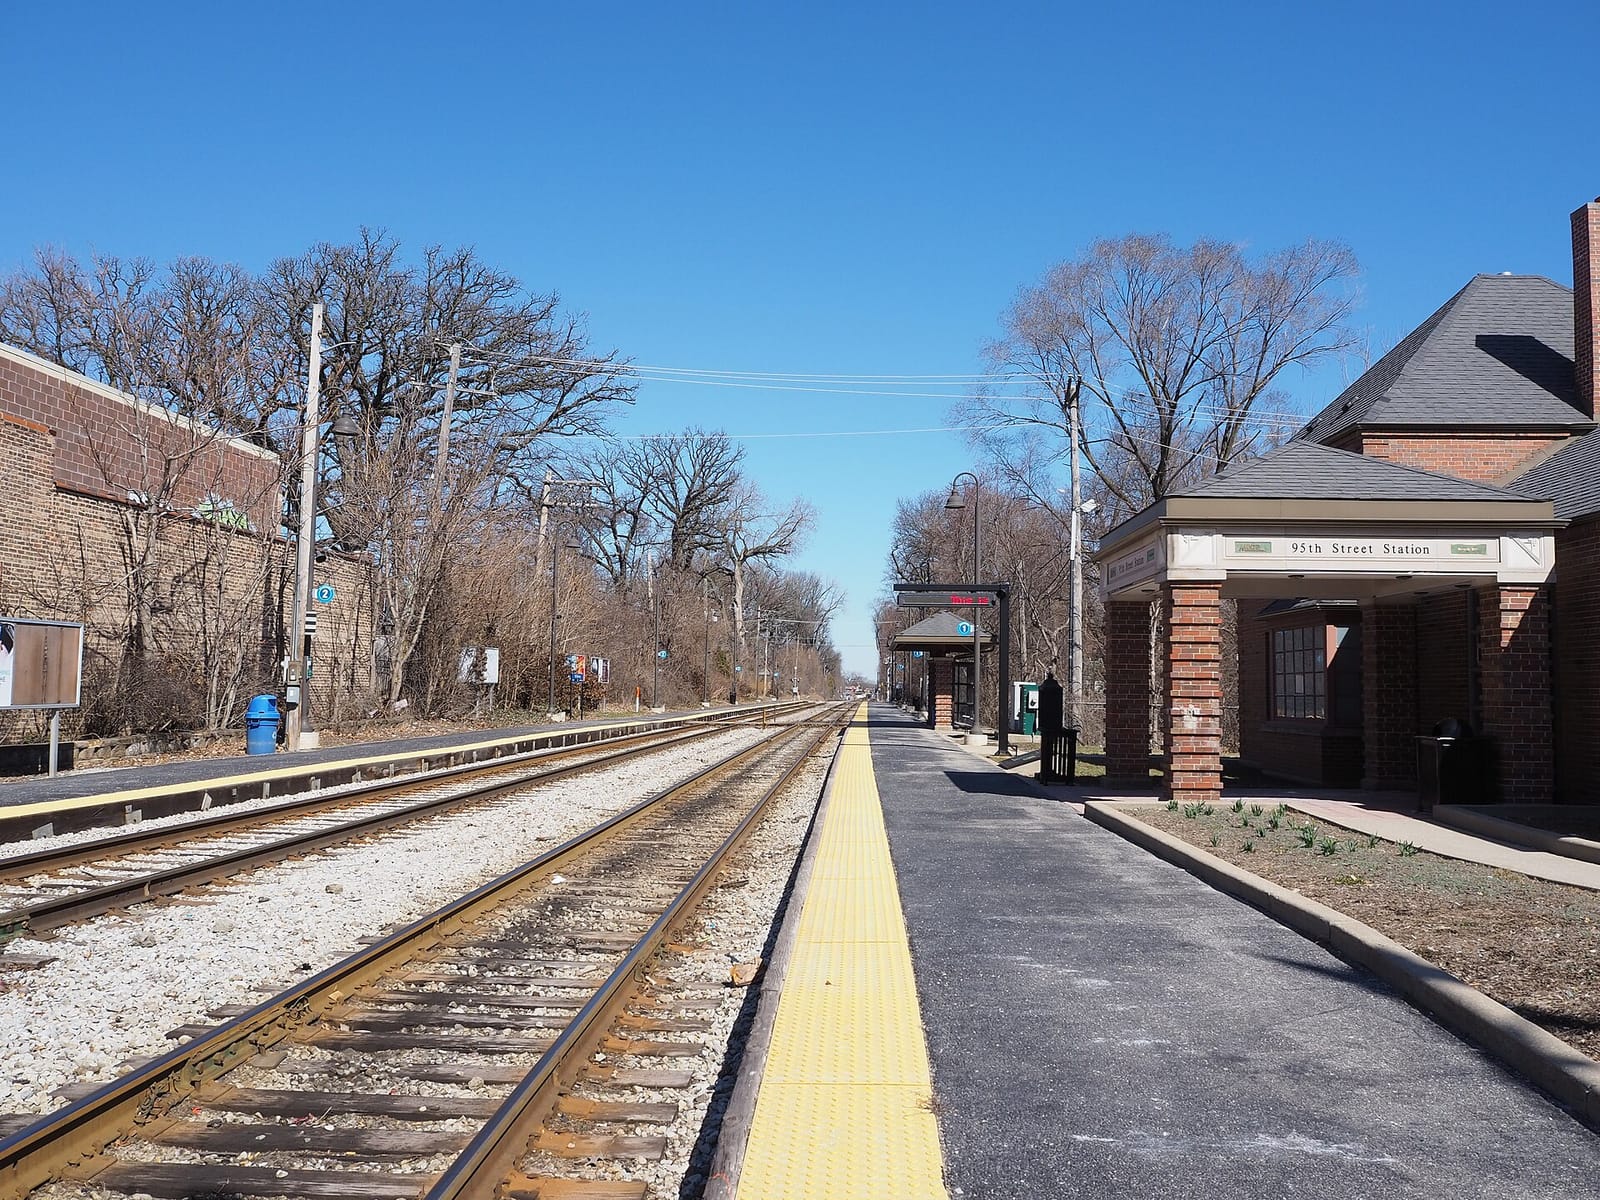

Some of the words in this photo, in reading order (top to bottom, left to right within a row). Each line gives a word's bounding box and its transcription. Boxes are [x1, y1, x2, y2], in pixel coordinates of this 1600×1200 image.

[1291, 542, 1322, 554] 95th
[1332, 543, 1373, 554] Street
[1383, 543, 1430, 555] Station
[322, 589, 329, 599] 2
[962, 624, 967, 633] 1
